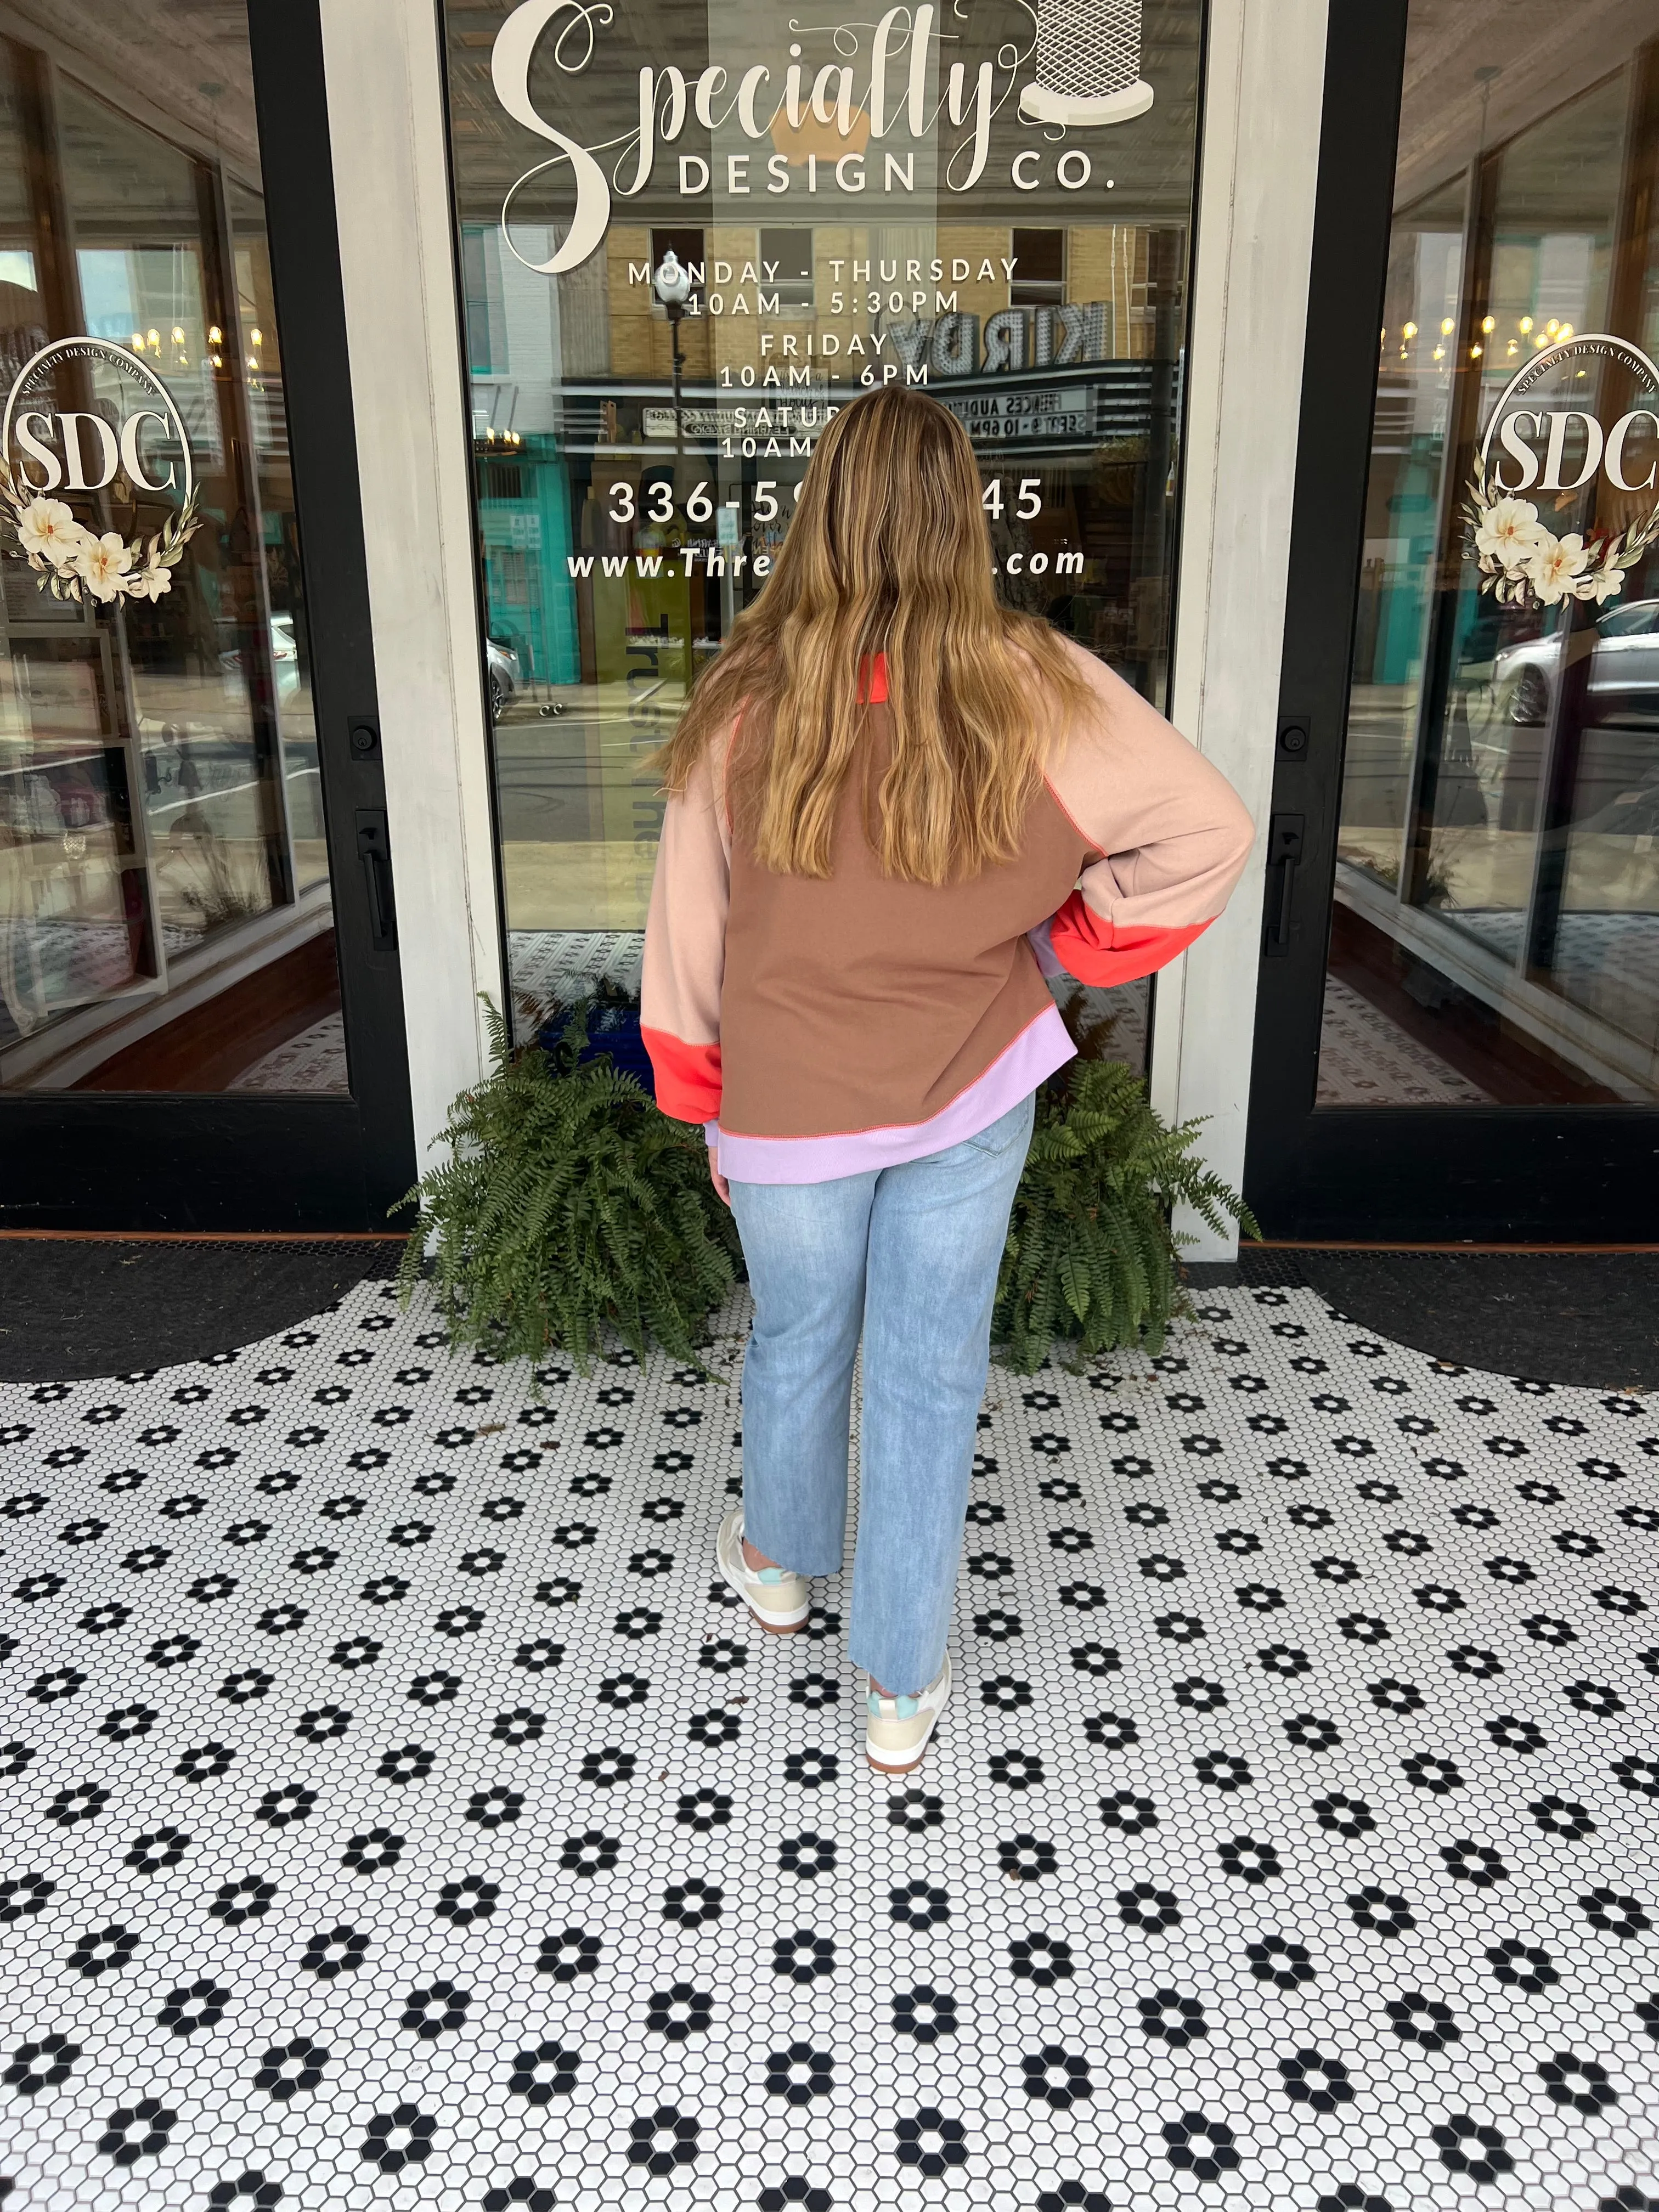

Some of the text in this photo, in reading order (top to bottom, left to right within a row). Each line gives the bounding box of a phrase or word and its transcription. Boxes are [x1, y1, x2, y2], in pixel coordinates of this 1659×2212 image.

[491, 0, 1036, 274] Specialty
[679, 150, 1115, 194] DESIGN CO.
[629, 261, 781, 285] MONDAY
[829, 258, 1018, 283] THURSDAY
[689, 292, 780, 315] 10AM
[831, 291, 957, 314] 5:30PM
[761, 334, 887, 356] FRIDAY
[22, 347, 155, 396] SPECIALTY DESIGN COMPANY
[720, 365, 810, 387] 10AM
[860, 364, 928, 386] 6PM
[1517, 345, 1657, 394] SPECIALTY DESIGN COMPANY
[15, 410, 177, 492] SDC
[722, 436, 810, 458] 10AM
[1494, 409, 1659, 492] SDC
[625, 613, 669, 753] Trust
